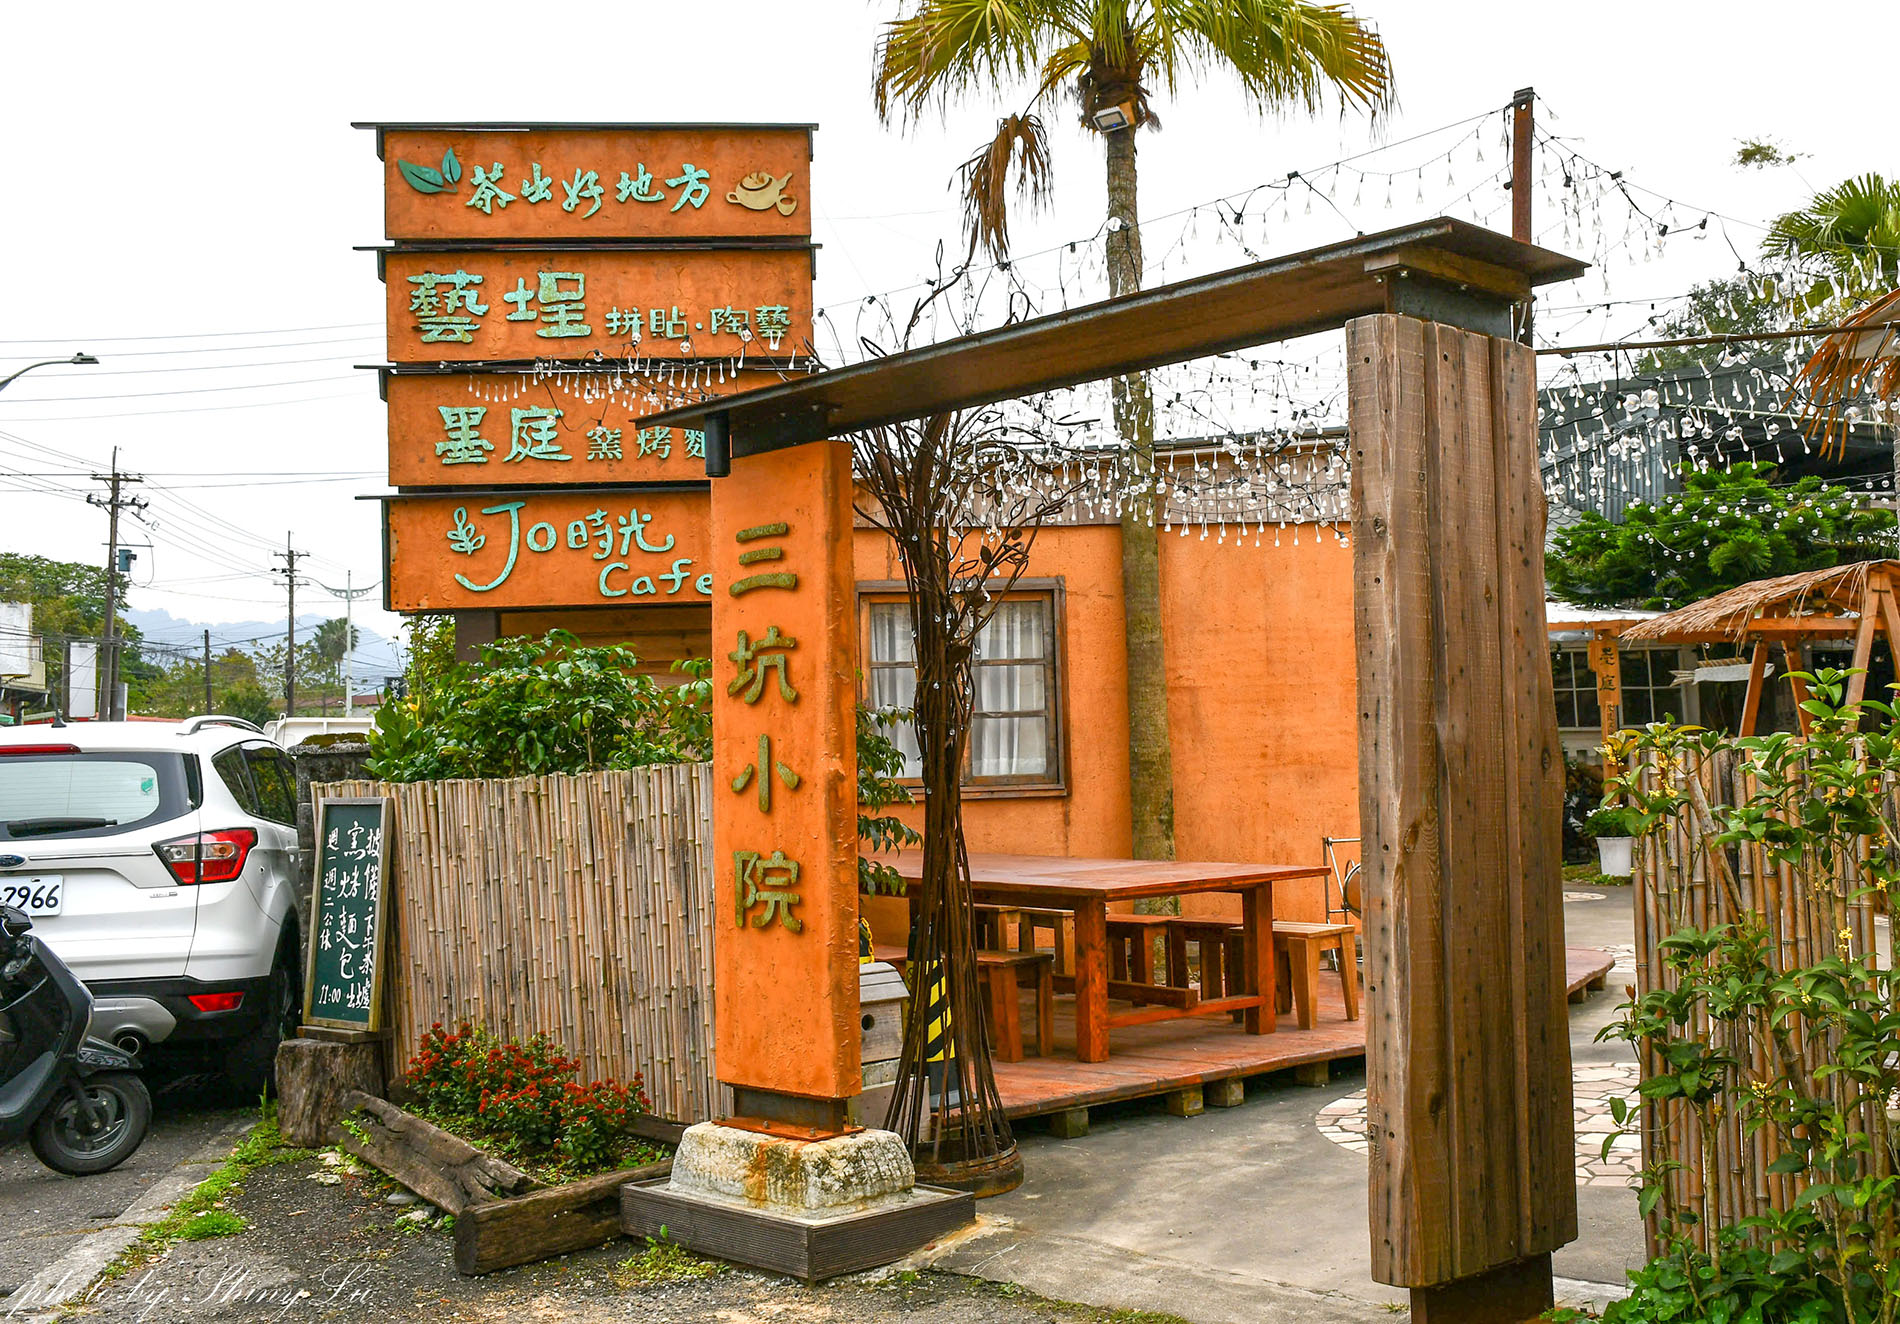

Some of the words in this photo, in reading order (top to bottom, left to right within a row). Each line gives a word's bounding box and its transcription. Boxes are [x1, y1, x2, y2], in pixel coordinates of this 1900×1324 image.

[466, 161, 712, 219] 茶出好地方
[406, 269, 592, 344] 藝埕
[435, 404, 573, 465] 墨庭
[599, 558, 713, 597] Cafe
[727, 521, 802, 933] 三坑小院
[319, 827, 340, 952] 週一週二公休
[336, 820, 366, 980] 窯烤麵包
[318, 984, 342, 1005] 11:00
